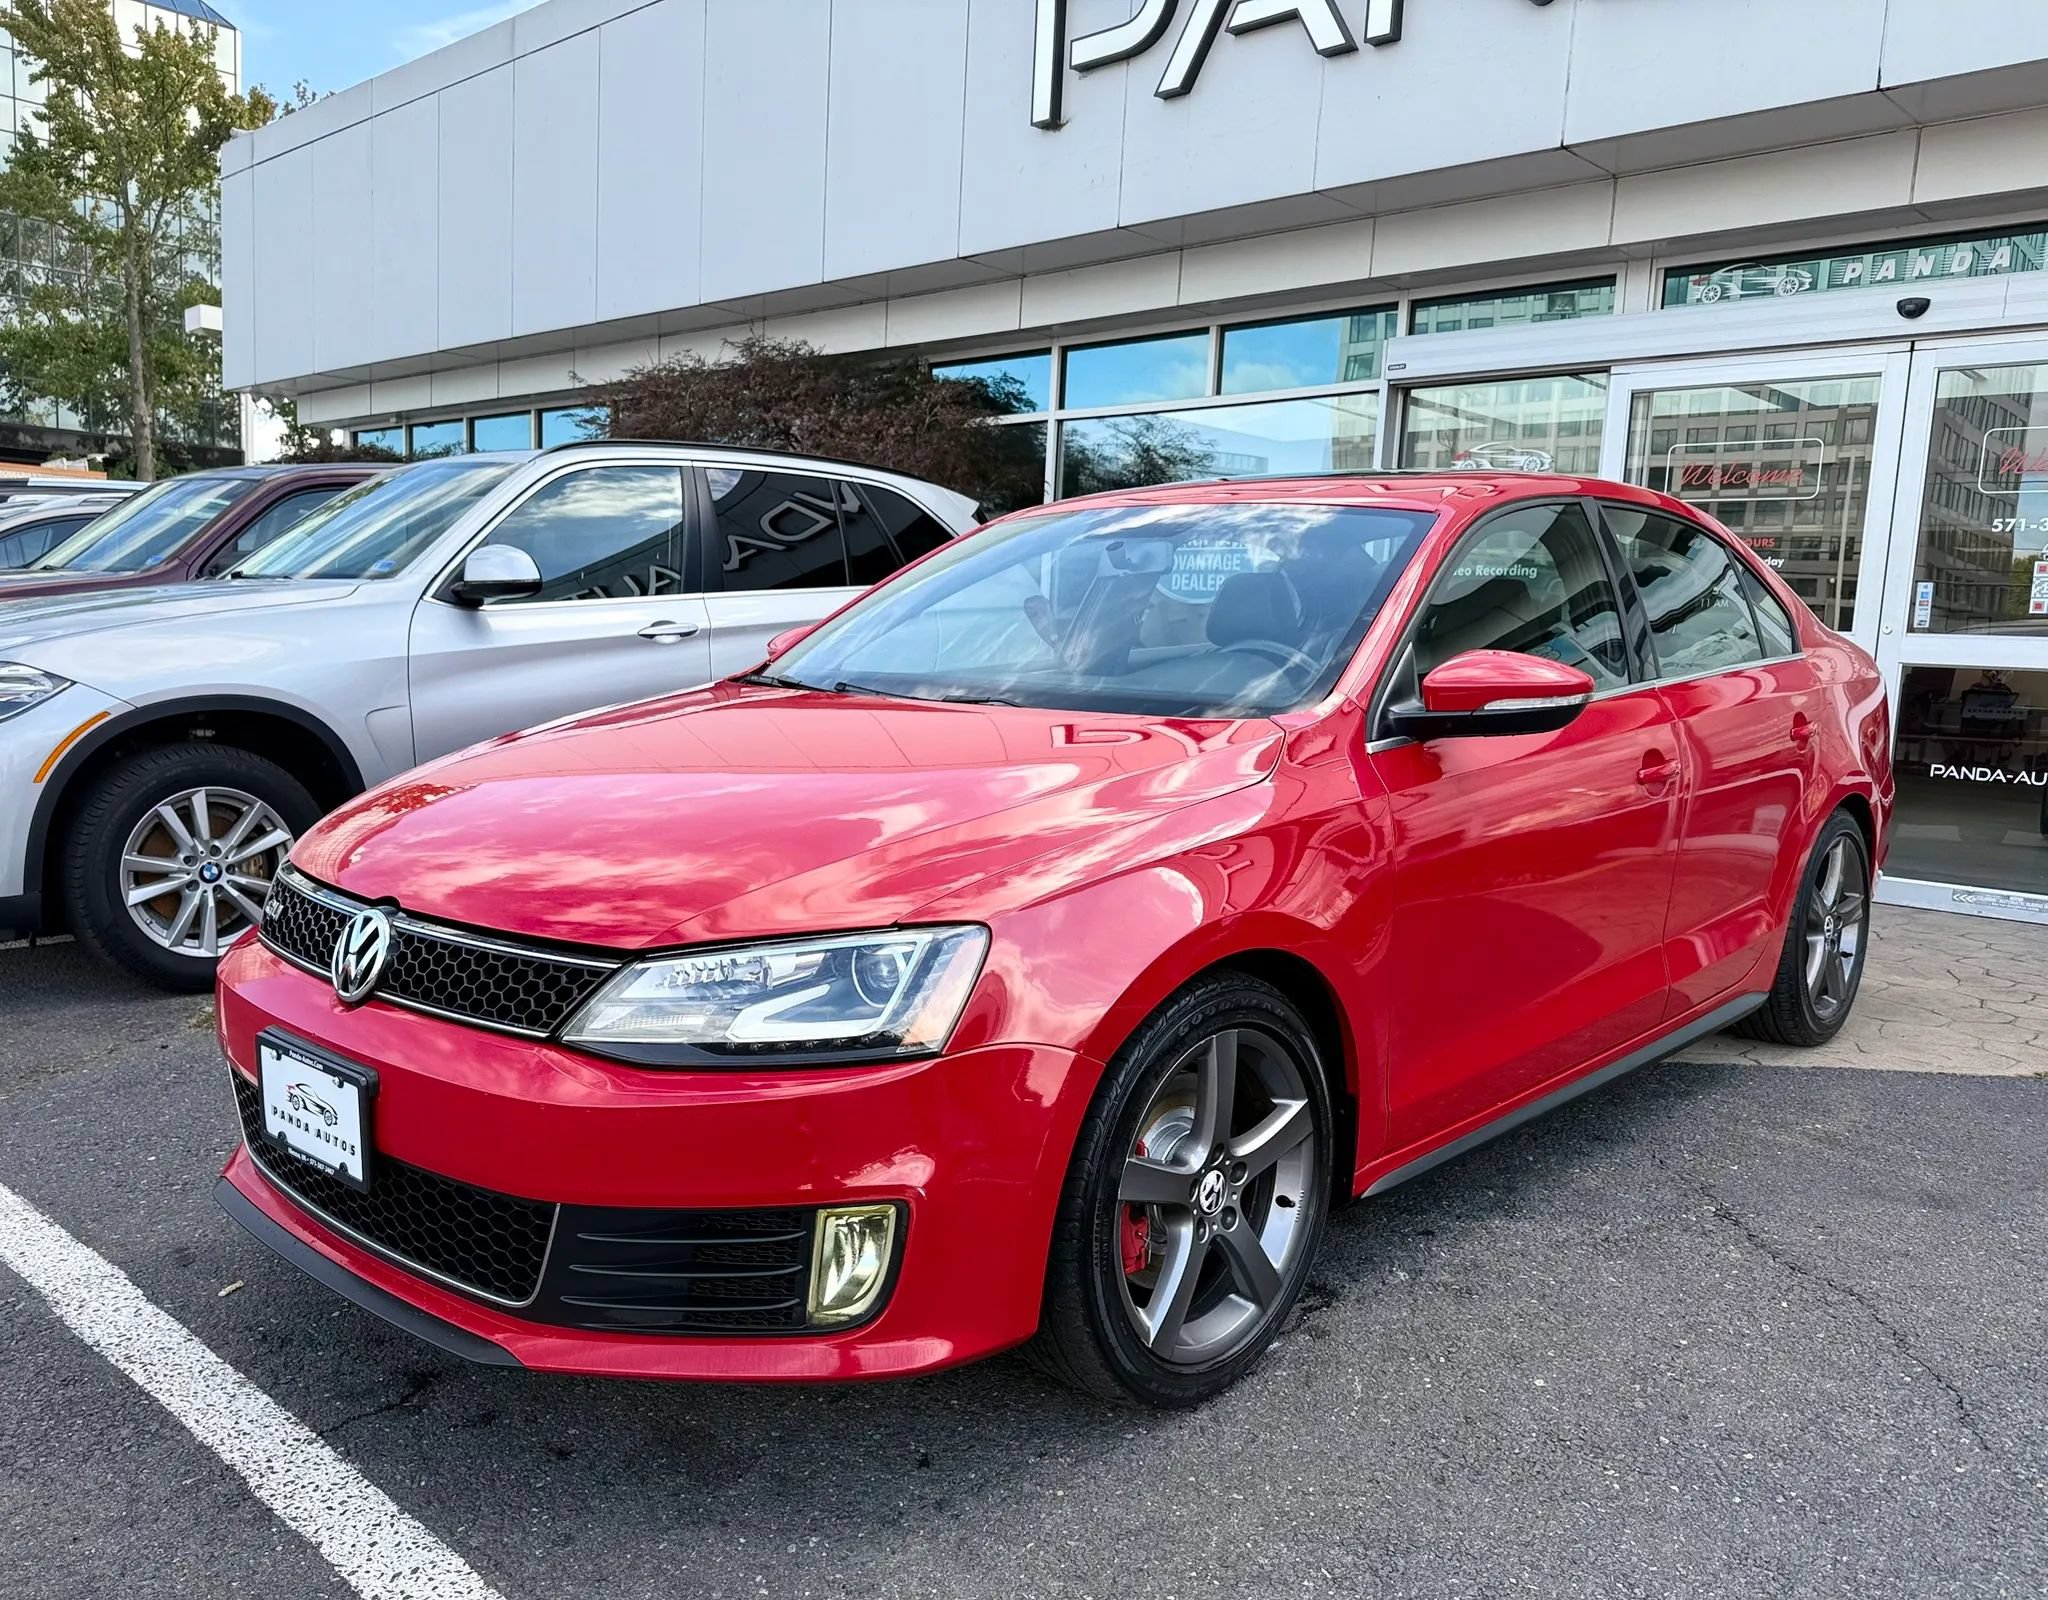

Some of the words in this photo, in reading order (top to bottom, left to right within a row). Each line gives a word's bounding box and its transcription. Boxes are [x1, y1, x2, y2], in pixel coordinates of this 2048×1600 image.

[1842, 246, 2011, 284] PANDA
[1680, 459, 1804, 486] Welcome
[1742, 536, 1776, 549] OURS
[1173, 551, 1241, 571] VANTAGE
[1764, 555, 1785, 568] day
[1475, 564, 1538, 579] Recording
[1713, 599, 1729, 608] AM
[1929, 763, 2048, 786] PANDA-AU
[271, 1104, 310, 1133] PANDA
[314, 1128, 356, 1157] AUTOS
